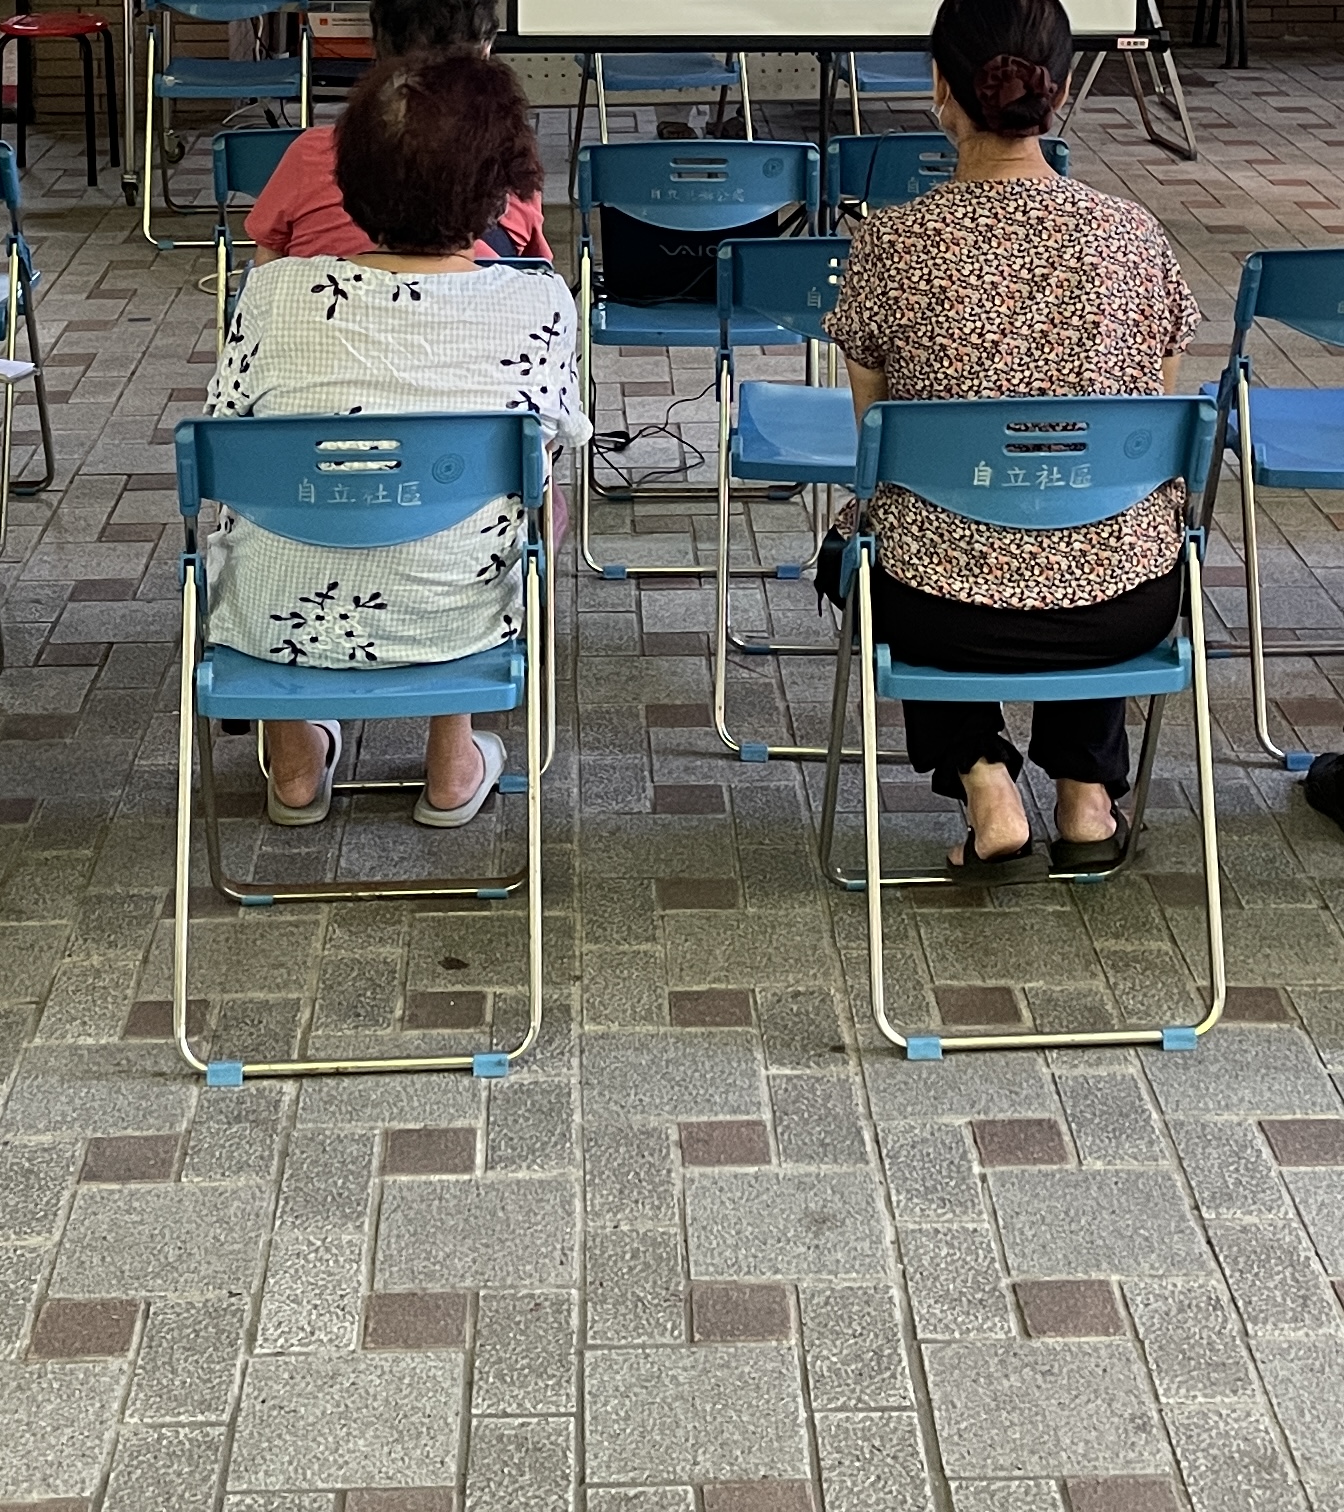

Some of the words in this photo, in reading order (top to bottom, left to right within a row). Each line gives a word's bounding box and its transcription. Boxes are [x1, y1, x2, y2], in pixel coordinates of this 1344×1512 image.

[972, 460, 1093, 491] 自立社區
[297, 477, 422, 507] 自立社區
